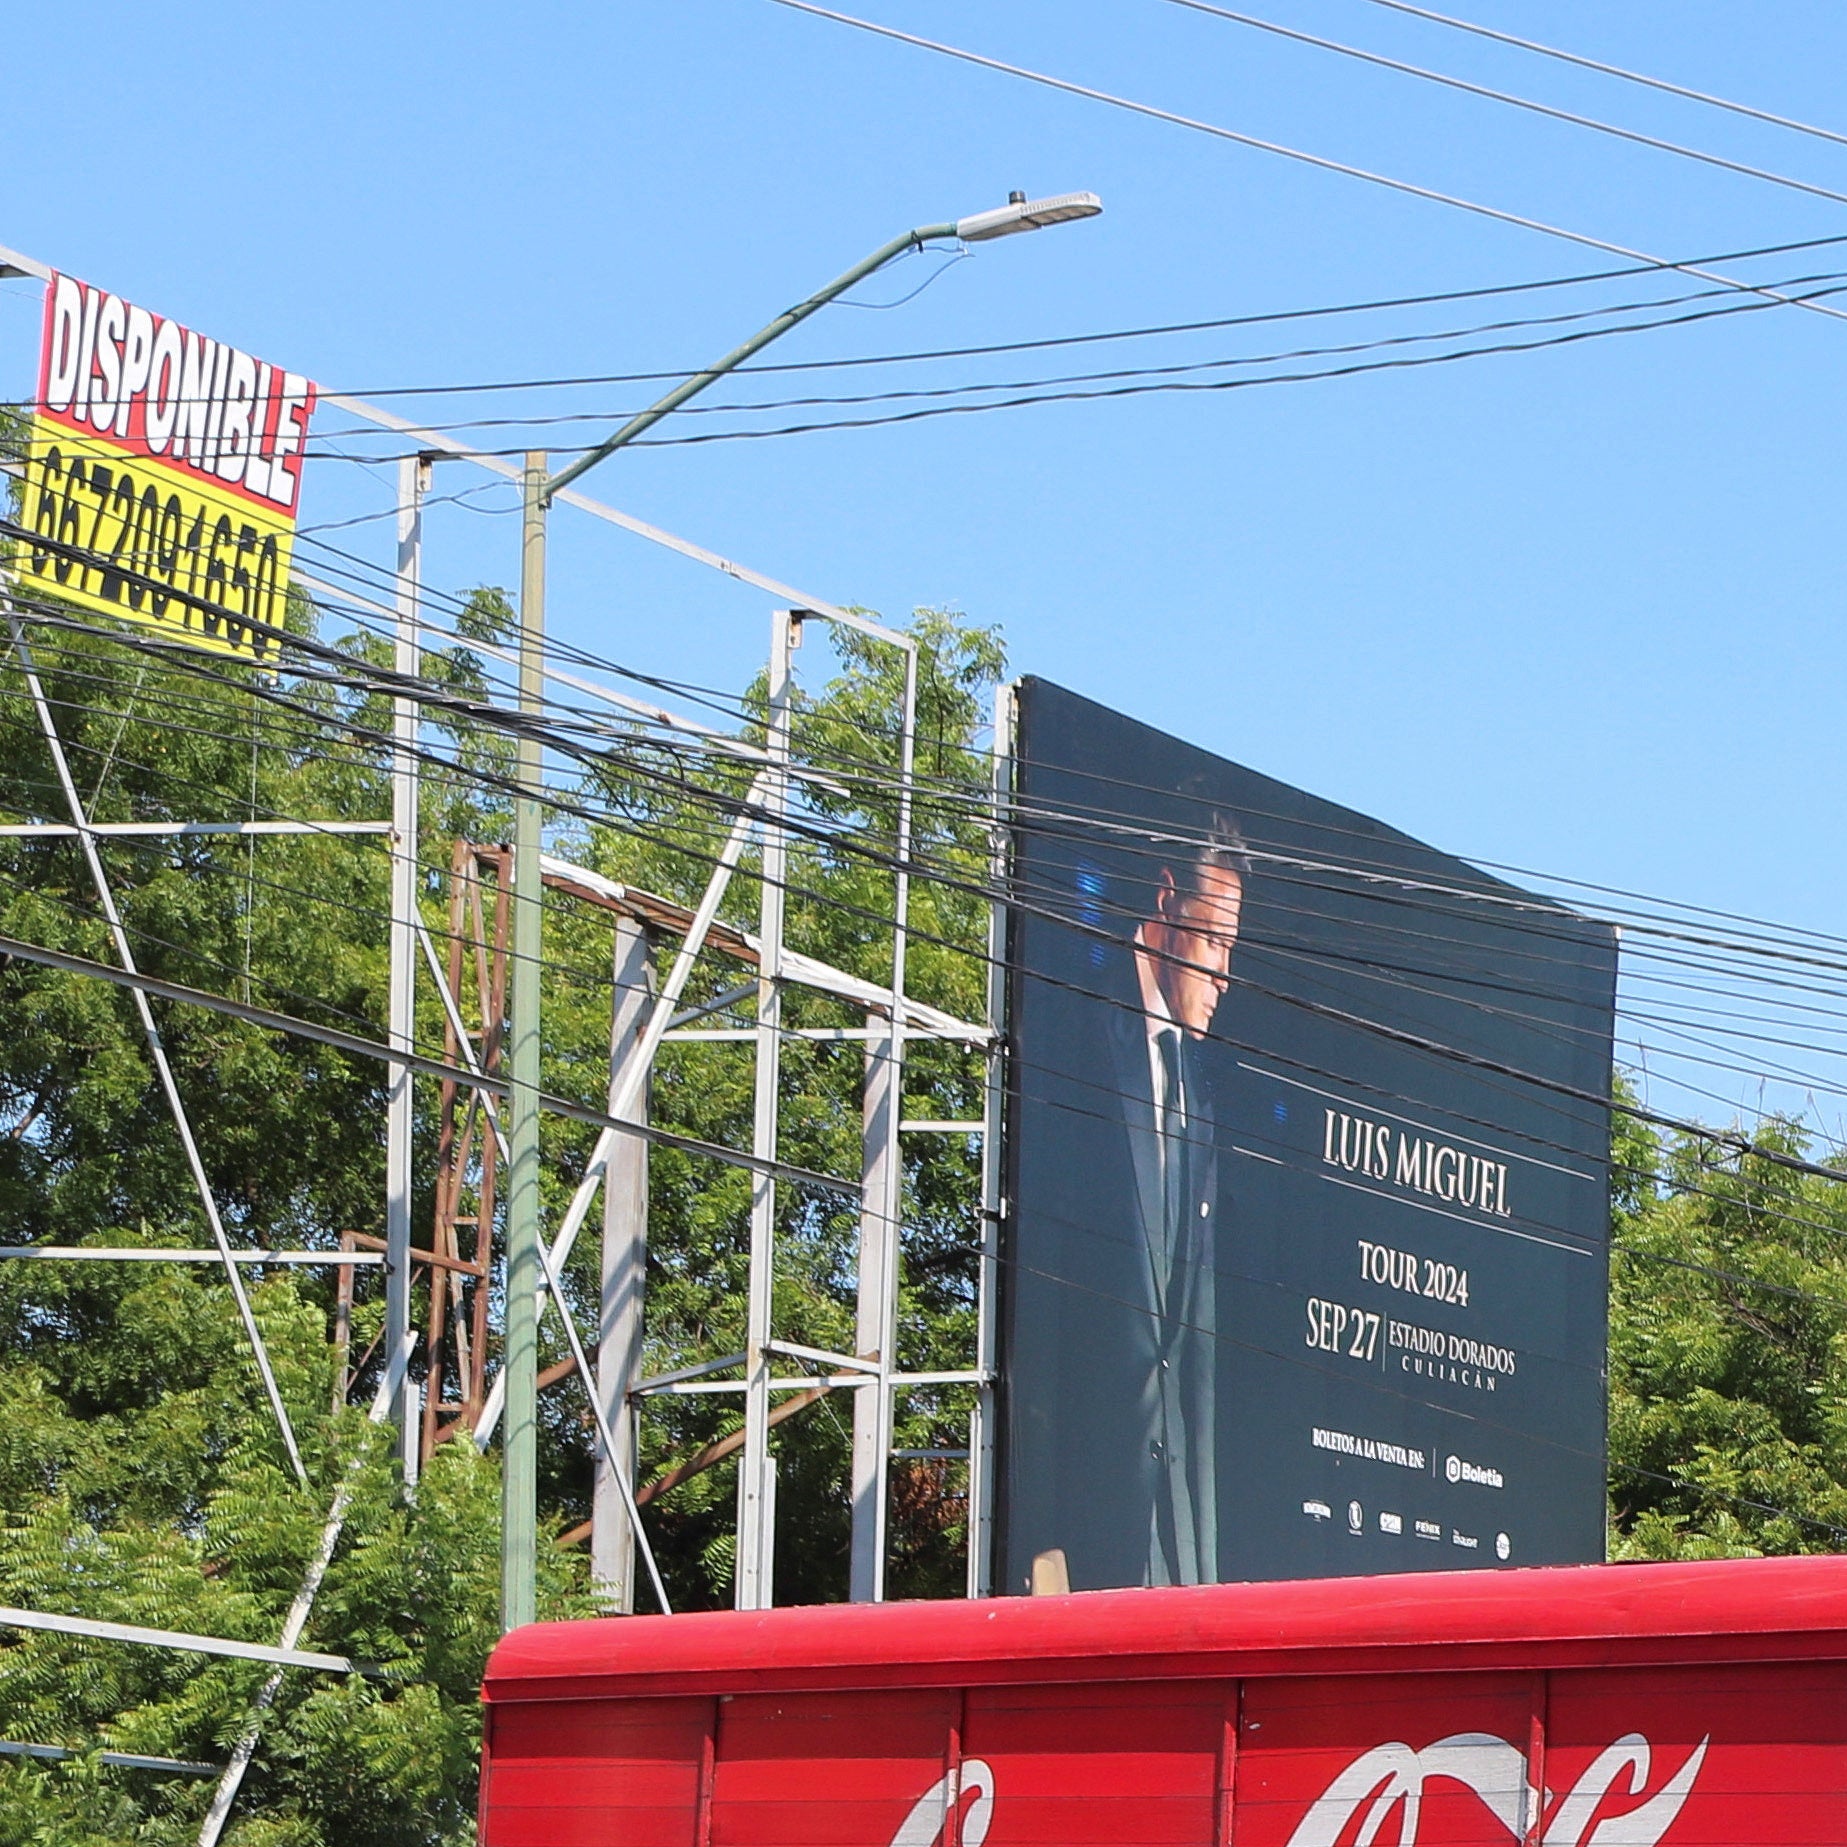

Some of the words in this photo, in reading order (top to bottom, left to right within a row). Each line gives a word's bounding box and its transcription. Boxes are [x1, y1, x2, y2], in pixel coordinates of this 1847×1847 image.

[45, 273, 309, 508] DISPONIBLE
[32, 446, 280, 659] 6672091650
[1323, 1108, 1391, 1180] LUIS
[1394, 1132, 1511, 1219] MIGUEL
[1357, 1240, 1420, 1295] TOUR
[1424, 1259, 1469, 1307] 2024
[1306, 1297, 1347, 1354] SEP
[1350, 1307, 1380, 1361] 27
[1389, 1319, 1446, 1359] ESTADIO
[1448, 1334, 1517, 1375] DORADOS
[1401, 1355, 1496, 1392] CULIACÁN
[1311, 1427, 1354, 1453] BOLETOS
[1355, 1437, 1363, 1457] A
[1364, 1438, 1376, 1460] LA
[1376, 1441, 1406, 1467] VENTA
[1461, 1461, 1504, 1489] Boletia
